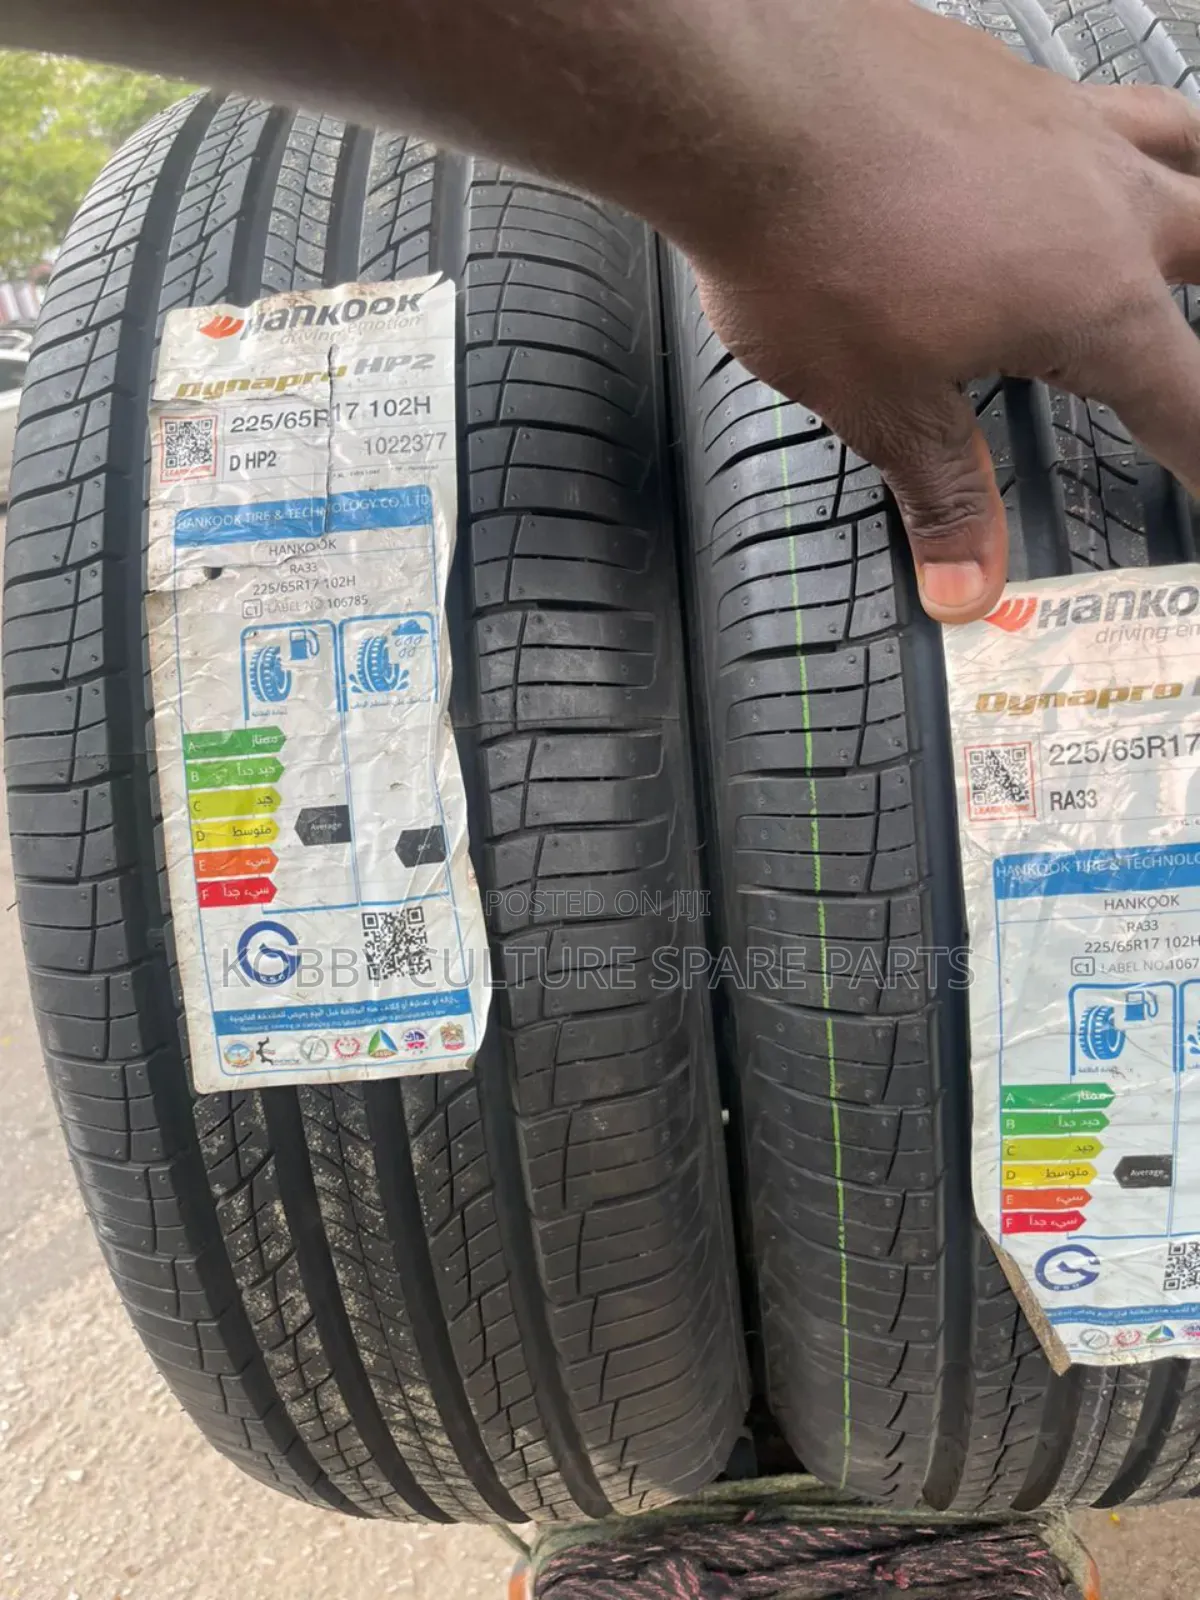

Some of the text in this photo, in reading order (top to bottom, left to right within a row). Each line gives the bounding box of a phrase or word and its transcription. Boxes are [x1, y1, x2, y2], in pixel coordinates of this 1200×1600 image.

[175, 353, 436, 399] Dynapro HP2
[230, 395, 432, 433] 225/65R17 102H
[365, 432, 447, 456] 1022377
[229, 450, 277, 471] D HP2
[177, 514, 242, 529] HANKOOK
[246, 510, 271, 522] TIRE
[274, 510, 282, 520] &
[269, 539, 337, 556] HANKOOK
[290, 562, 317, 574] RA33
[253, 576, 356, 596] 225/65R17 102H
[244, 605, 258, 616] C1
[1095, 625, 1168, 645] driving
[975, 682, 1184, 716] Dynapro
[251, 730, 279, 747] ممتاز
[187, 742, 196, 753] A
[1049, 733, 1200, 766] 225/65R17
[191, 771, 199, 782] B
[193, 800, 202, 812] C
[256, 796, 274, 806] جيد
[1050, 789, 1097, 811] RA33
[232, 825, 272, 839] متوسط
[310, 822, 343, 832] Average
[196, 830, 205, 842] D
[199, 860, 206, 871] E
[996, 859, 1071, 877] HANKOOK
[1075, 858, 1109, 873] TIRE
[202, 889, 209, 901] F
[1104, 895, 1180, 911] HANKOOK
[1127, 919, 1159, 932] RA33
[1084, 935, 1200, 954] 225/65R17 102H
[1074, 963, 1090, 974] C1
[1100, 961, 1140, 974] LABEL
[1005, 1093, 1015, 1104] A
[1077, 1089, 1107, 1103] ممتاز
[1006, 1119, 1015, 1129] B
[1006, 1146, 1015, 1156] C
[1074, 1144, 1094, 1152] جيد
[1006, 1170, 1016, 1180] D
[1046, 1168, 1089, 1179] متوسط
[1130, 1168, 1164, 1178] Average
[1006, 1194, 1013, 1204] E
[1006, 1218, 1013, 1228] F
